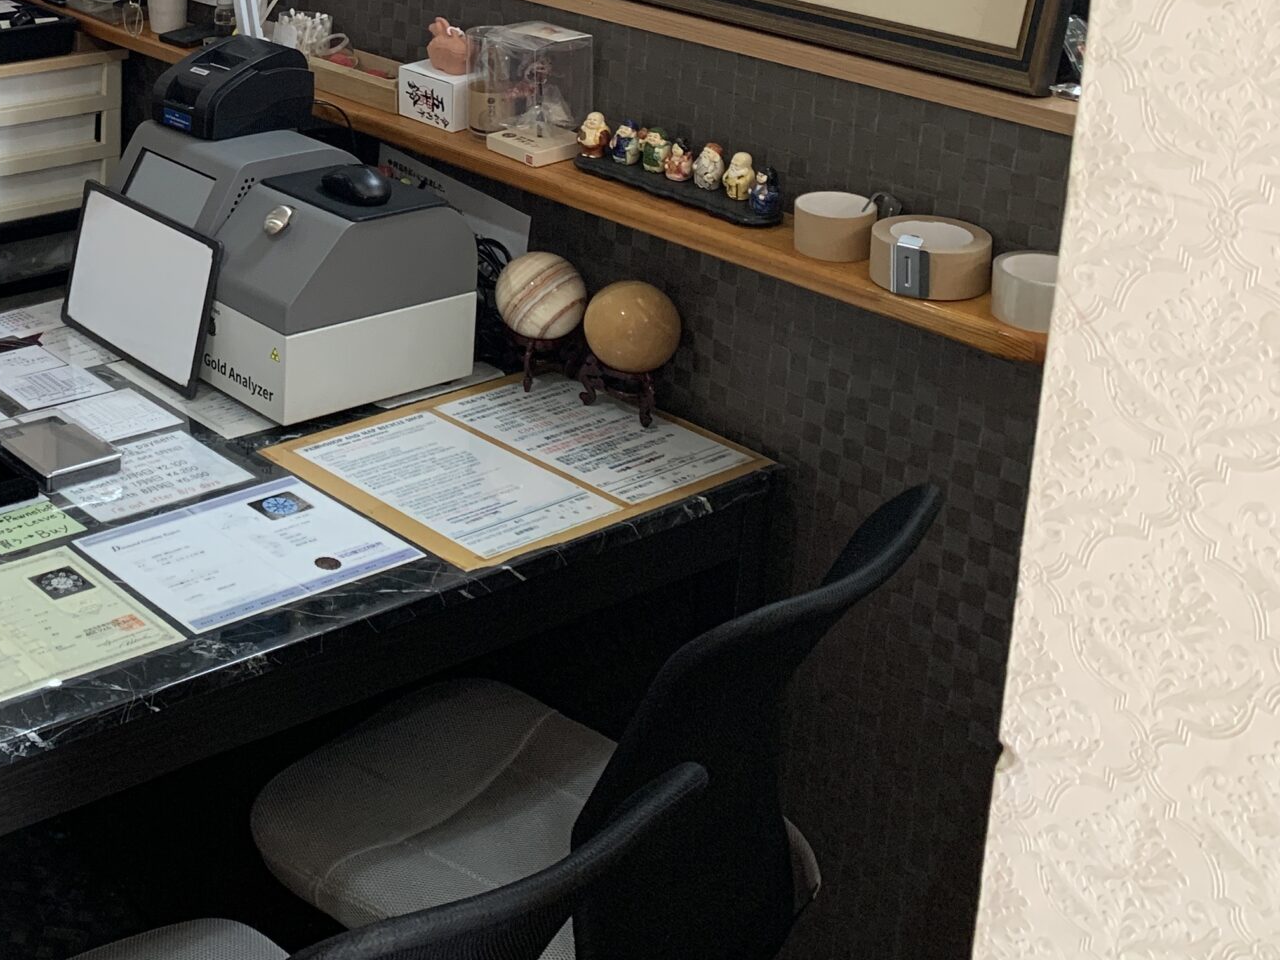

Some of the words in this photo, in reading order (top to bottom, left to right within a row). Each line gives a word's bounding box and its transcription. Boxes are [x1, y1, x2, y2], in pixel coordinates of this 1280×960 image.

[204, 353, 226, 375] Gold
[229, 367, 274, 402] Analyzer
[35, 525, 68, 539] Buy
